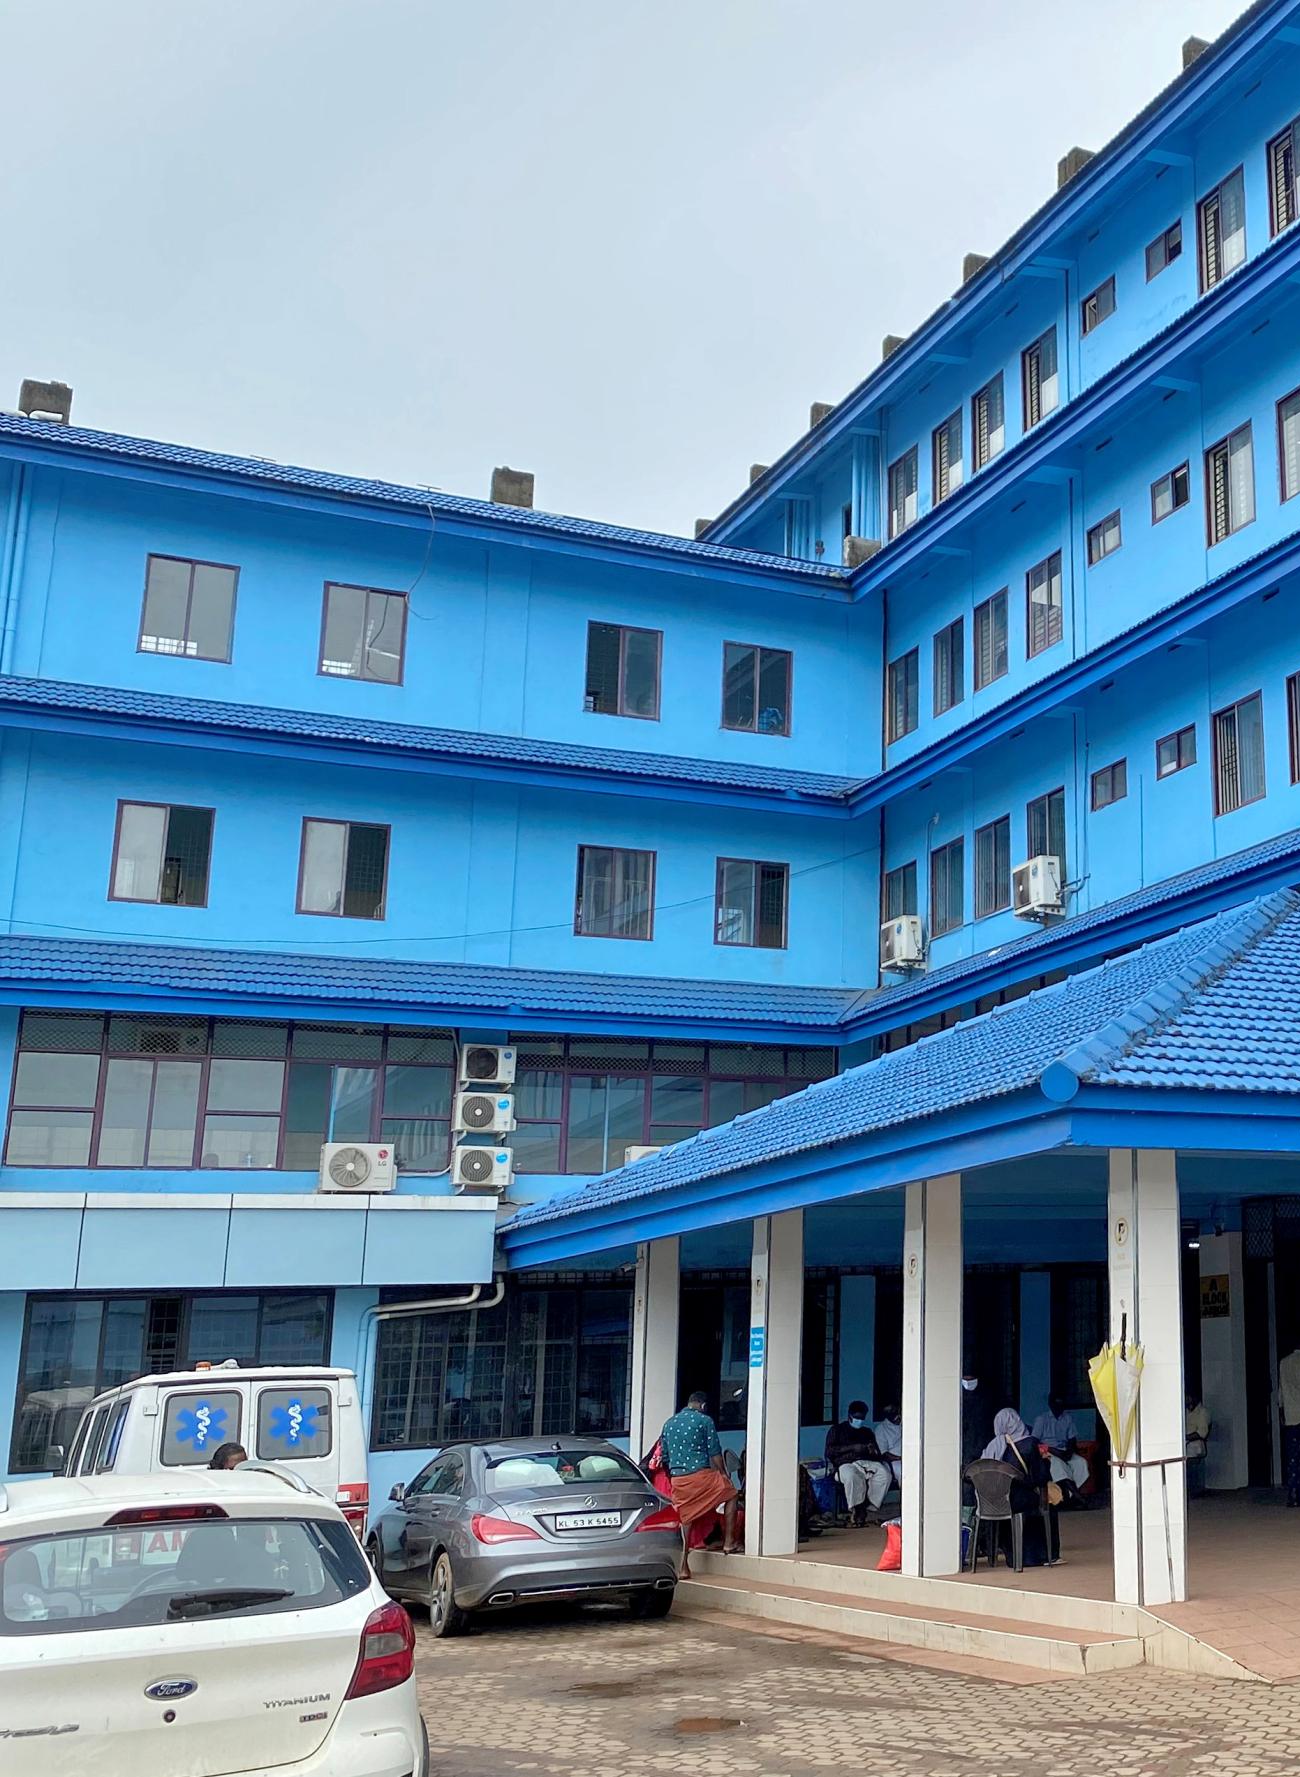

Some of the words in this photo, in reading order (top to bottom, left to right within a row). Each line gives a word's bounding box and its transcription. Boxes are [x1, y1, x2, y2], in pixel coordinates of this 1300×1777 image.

[558, 1519, 570, 1528] KL
[573, 1519, 585, 1527] 53
[587, 1518, 594, 1526] K
[596, 1516, 619, 1526] 5455
[157, 1681, 187, 1697] Ford
[263, 1692, 331, 1710] TITANIUM
